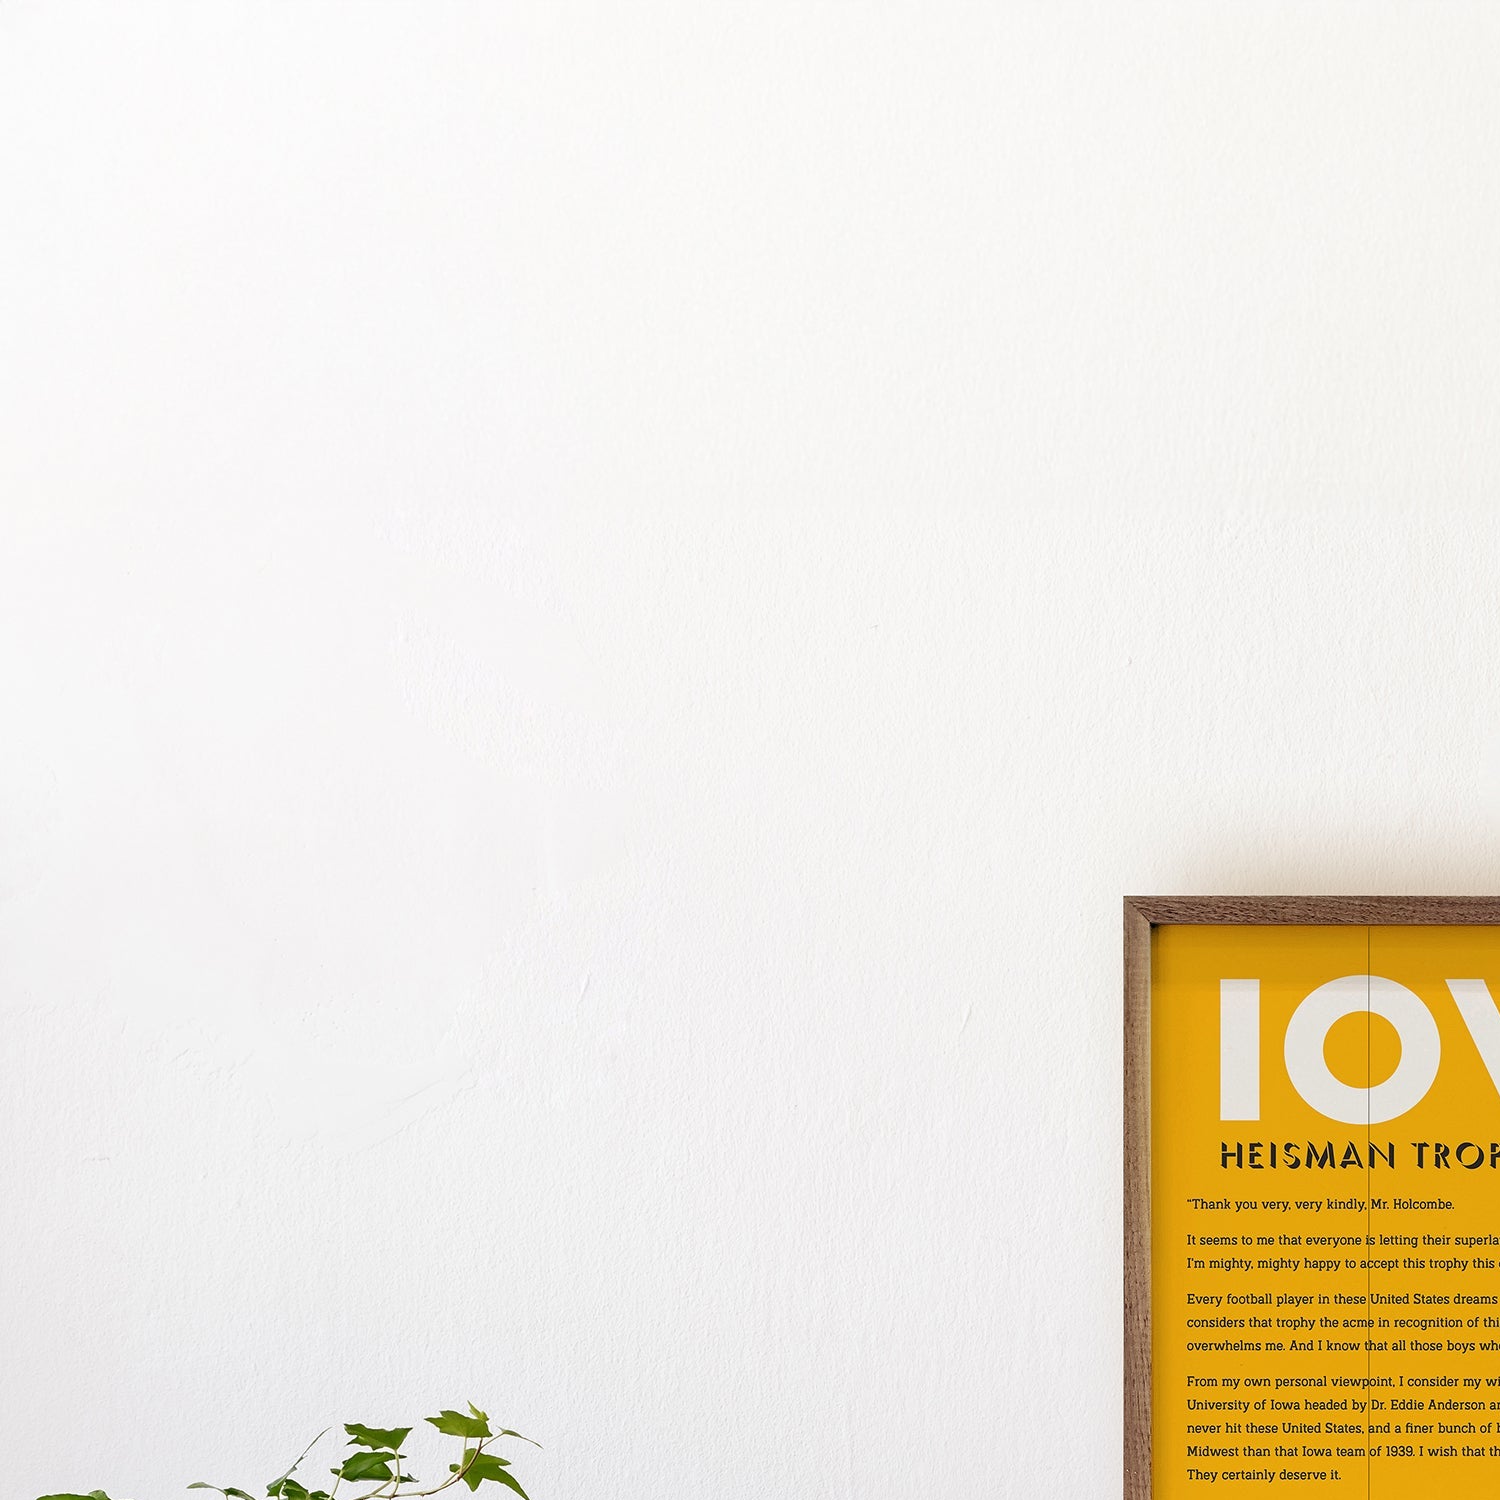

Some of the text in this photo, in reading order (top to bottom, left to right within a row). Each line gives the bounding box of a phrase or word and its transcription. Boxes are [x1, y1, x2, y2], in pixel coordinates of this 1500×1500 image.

[1220, 1141, 1395, 1170] HEISMAN
[1234, 1200, 1258, 1213] you
[1261, 1200, 1292, 1213] very,
[1294, 1200, 1323, 1213] very
[1326, 1198, 1368, 1214] kindly,
[1370, 1198, 1390, 1210] Mr.
[1392, 1198, 1455, 1210] Holcombe.
[1186, 1234, 1197, 1246] It
[1199, 1236, 1238, 1246] seems
[1240, 1235, 1253, 1246] to
[1256, 1236, 1275, 1246] me
[1278, 1233, 1303, 1246] that
[1305, 1236, 1363, 1249] everyone
[1365, 1233, 1376, 1246] is
[1379, 1233, 1419, 1249] letting
[1421, 1233, 1452, 1246] their
[1208, 1257, 1254, 1272] mighty,
[1257, 1257, 1301, 1272] mighty
[1303, 1257, 1342, 1272] happy
[1344, 1258, 1357, 1269] to
[1359, 1257, 1400, 1273] accept
[1402, 1257, 1426, 1269] this
[1428, 1257, 1470, 1272] trophy
[1471, 1257, 1496, 1269] this
[1186, 1339, 1262, 1352] overwhelms
[1264, 1342, 1286, 1352] me.
[1288, 1339, 1315, 1352] And
[1317, 1339, 1323, 1351] I
[1325, 1339, 1361, 1352] know
[1363, 1339, 1389, 1352] that
[1391, 1339, 1407, 1352] all
[1409, 1339, 1443, 1352] those
[1446, 1339, 1476, 1355] boys
[1186, 1468, 1342, 1484] They certainly deserve it.
